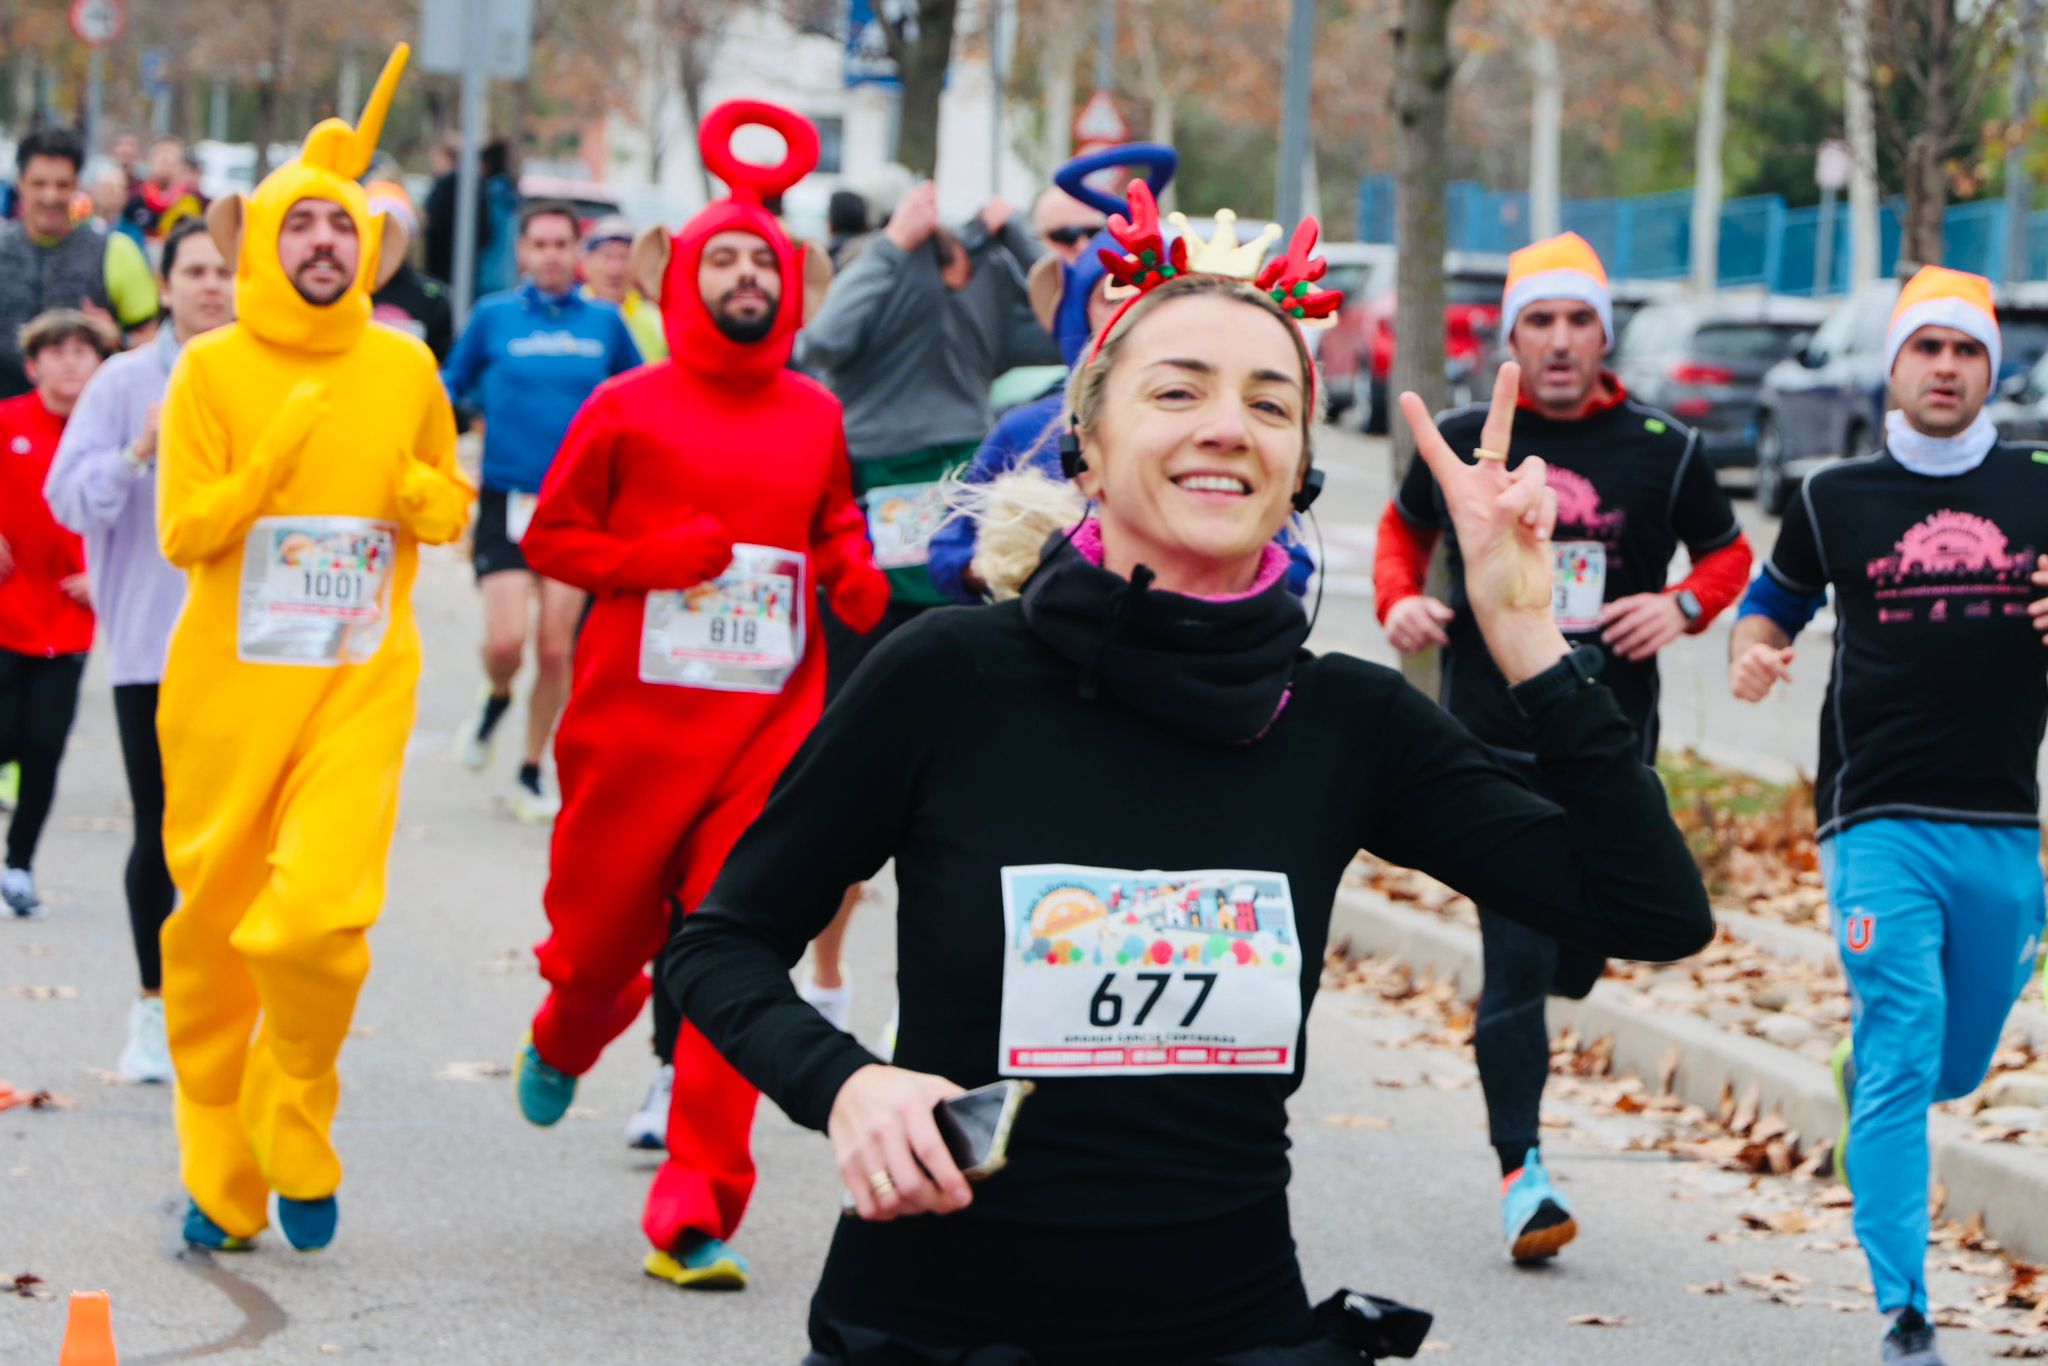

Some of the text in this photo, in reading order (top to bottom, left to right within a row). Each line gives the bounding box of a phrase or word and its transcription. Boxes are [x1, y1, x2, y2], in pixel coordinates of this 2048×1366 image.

[304, 571, 362, 600] 1001
[710, 618, 757, 645] 818
[1849, 917, 1873, 952] U
[1089, 973, 1217, 1027] 677
